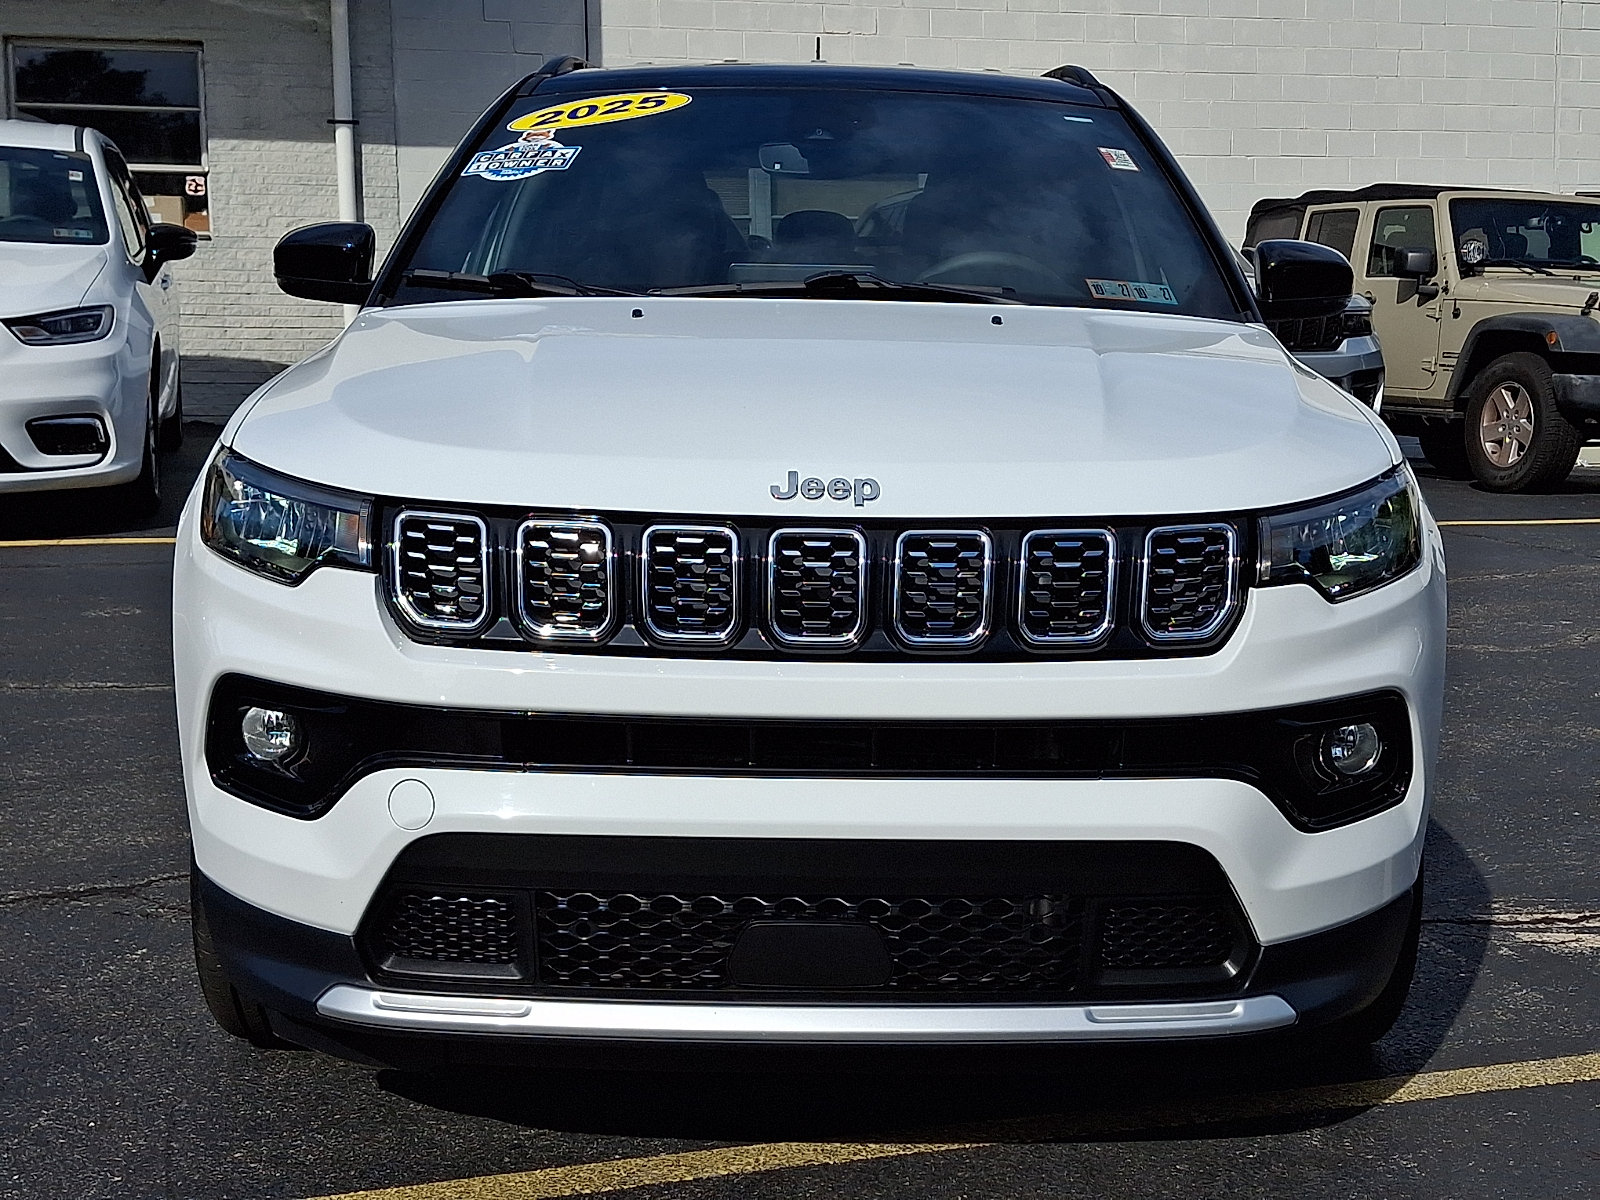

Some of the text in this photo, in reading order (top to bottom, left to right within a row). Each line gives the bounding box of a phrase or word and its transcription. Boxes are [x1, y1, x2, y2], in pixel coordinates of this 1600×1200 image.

[531, 95, 670, 127] 2025
[480, 150, 570, 162] CARFAX
[488, 159, 563, 169] OWNER
[1091, 283, 1131, 298] 10 27
[1134, 287, 1148, 299] 10
[770, 470, 881, 507] Jeep
